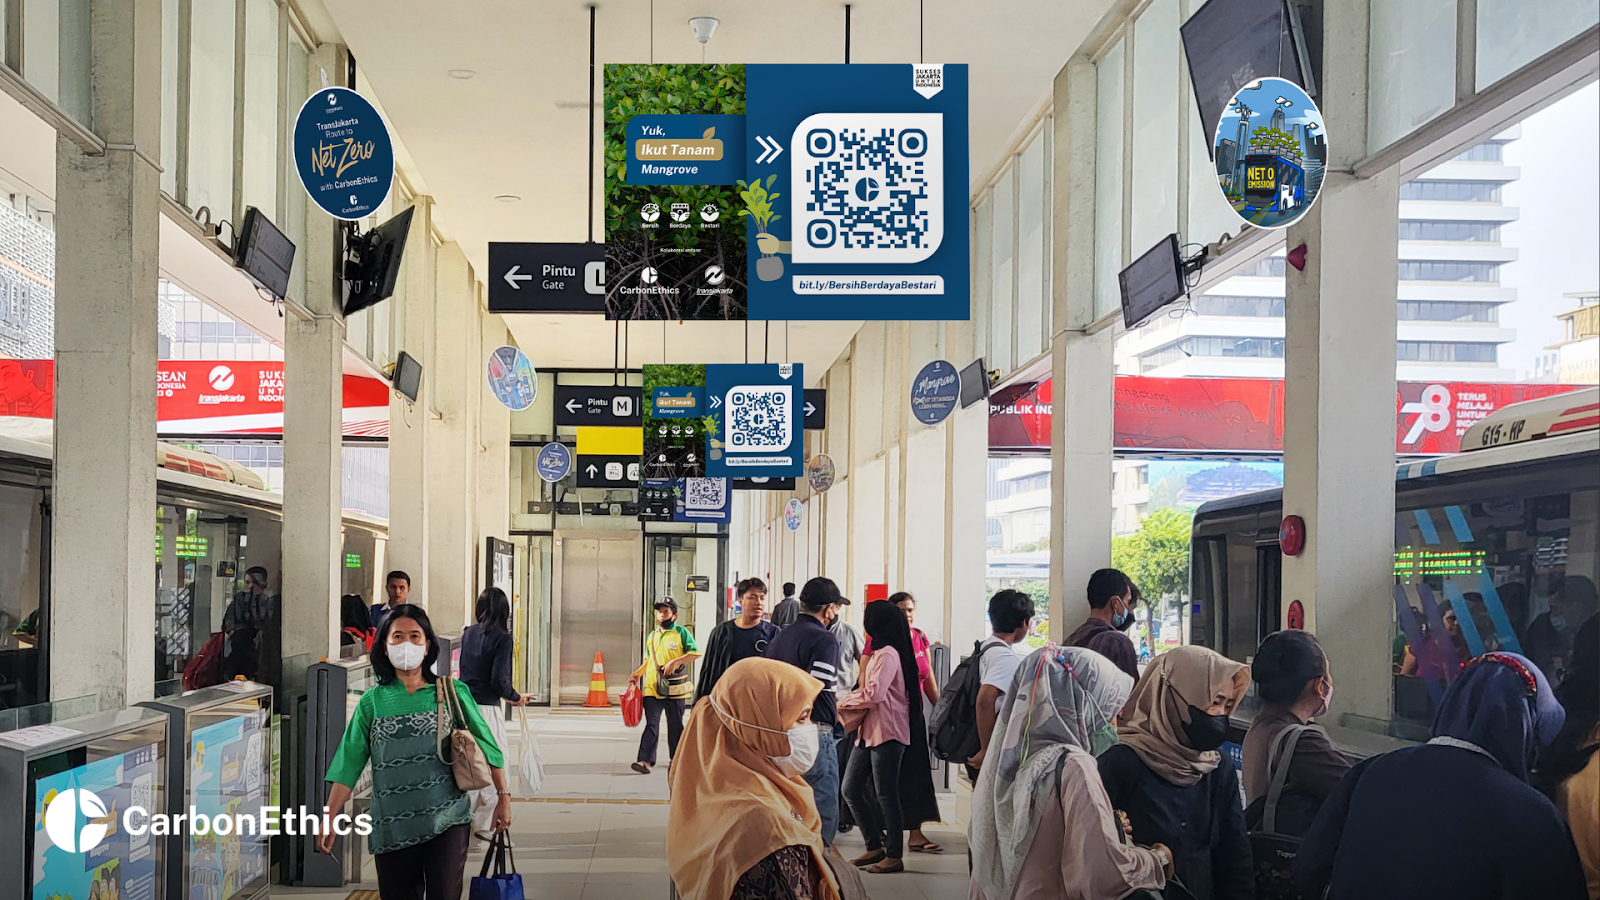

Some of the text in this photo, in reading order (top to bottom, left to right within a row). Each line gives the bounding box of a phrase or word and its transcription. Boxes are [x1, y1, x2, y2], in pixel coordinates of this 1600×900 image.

[316, 118, 359, 130] TransJakarta
[326, 130, 345, 138] Route
[641, 125, 666, 137] Yuk,
[641, 144, 715, 155] Ikut Tanam
[312, 138, 375, 178] Net Zero
[641, 164, 698, 176] Mangrove
[1247, 167, 1266, 180] NET
[320, 176, 378, 191] with CarbonEthics
[1247, 181, 1275, 189] EMISSION
[542, 264, 576, 277] Pintu
[542, 280, 565, 290] Gate
[620, 286, 680, 294] CarbonEthics
[799, 280, 937, 290] bit.ly/BersihBerdayaBestari
[918, 373, 956, 395] Mangrove
[198, 394, 245, 404] transjakarta
[1114, 388, 1170, 403] nnecting
[1457, 393, 1487, 401] TERUS
[587, 398, 609, 406] Pintu
[616, 401, 628, 412] M
[1456, 401, 1493, 410] MELAJU
[587, 406, 601, 414] Gate
[990, 405, 1033, 414] PUBLIK
[1456, 410, 1487, 419] UNTUK
